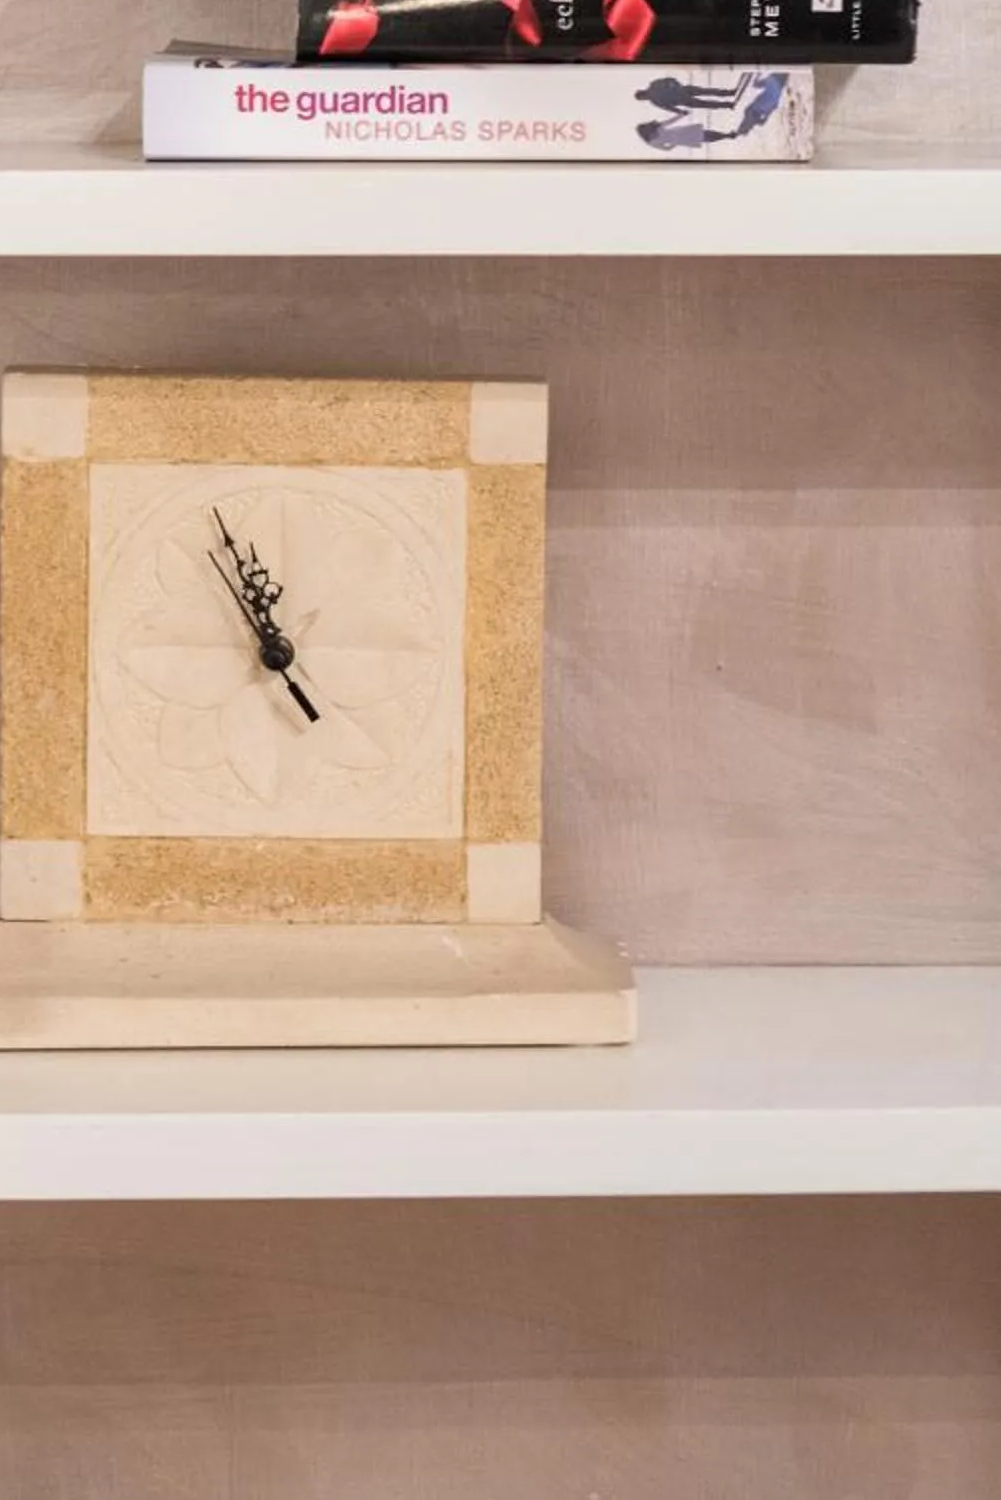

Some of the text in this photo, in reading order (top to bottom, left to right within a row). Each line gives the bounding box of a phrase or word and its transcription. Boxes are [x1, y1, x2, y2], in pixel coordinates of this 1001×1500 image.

[235, 84, 448, 120] the guardian
[324, 120, 587, 141] NICHOLAS SPARKS
